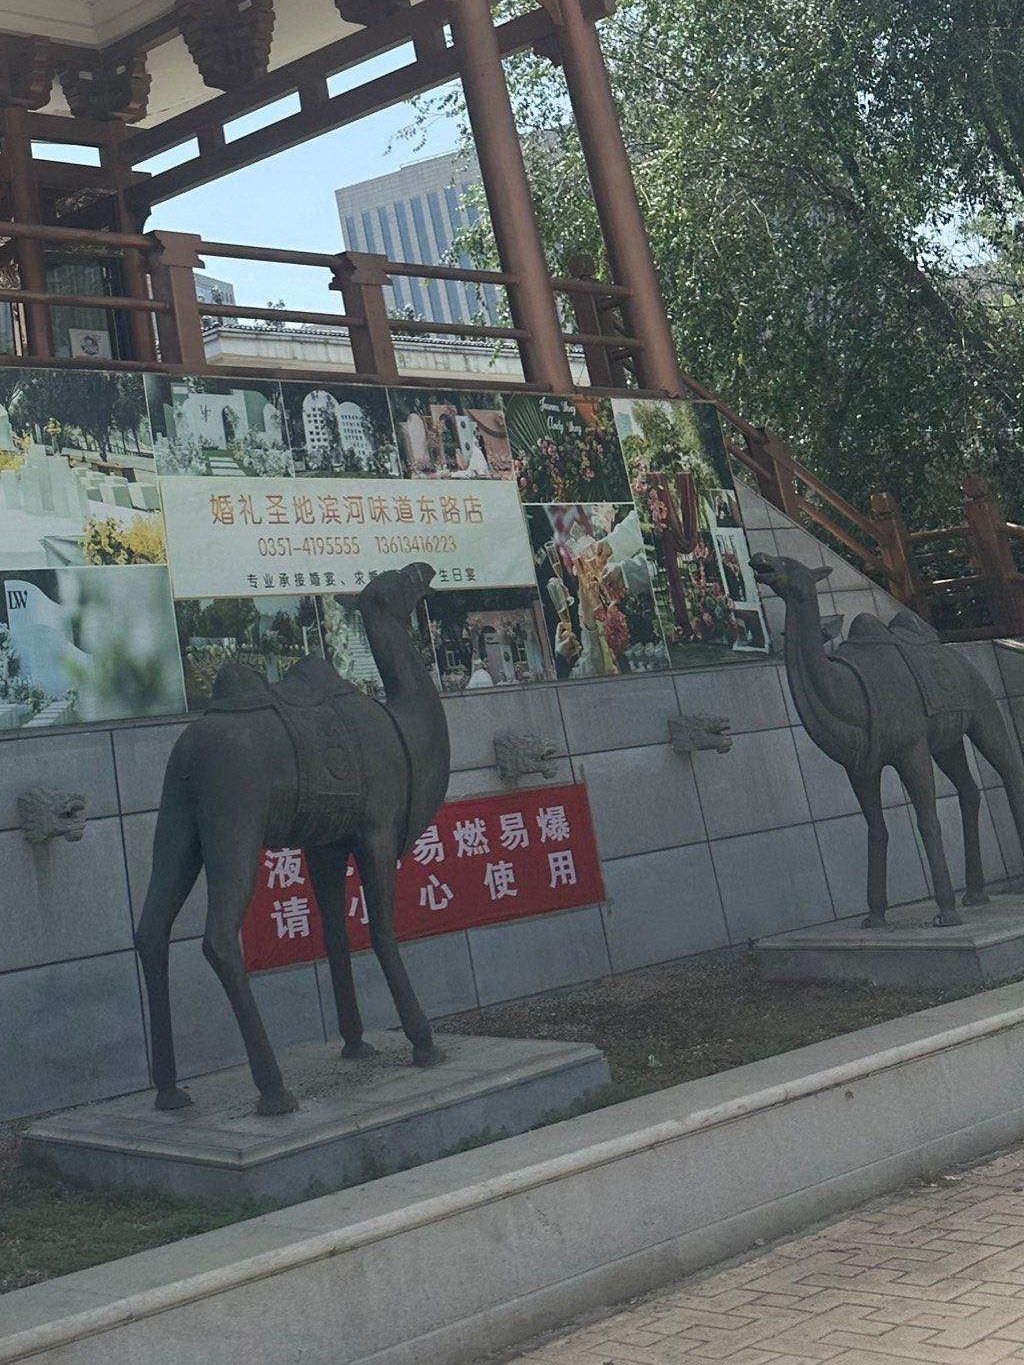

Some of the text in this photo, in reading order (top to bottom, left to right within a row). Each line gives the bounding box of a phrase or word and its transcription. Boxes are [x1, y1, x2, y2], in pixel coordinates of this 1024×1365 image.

[209, 493, 484, 526] 婚礼圣地滨河味道东路店
[258, 535, 458, 557] 0351-4195555 13613416223
[263, 805, 571, 890] 液易燃易爆
